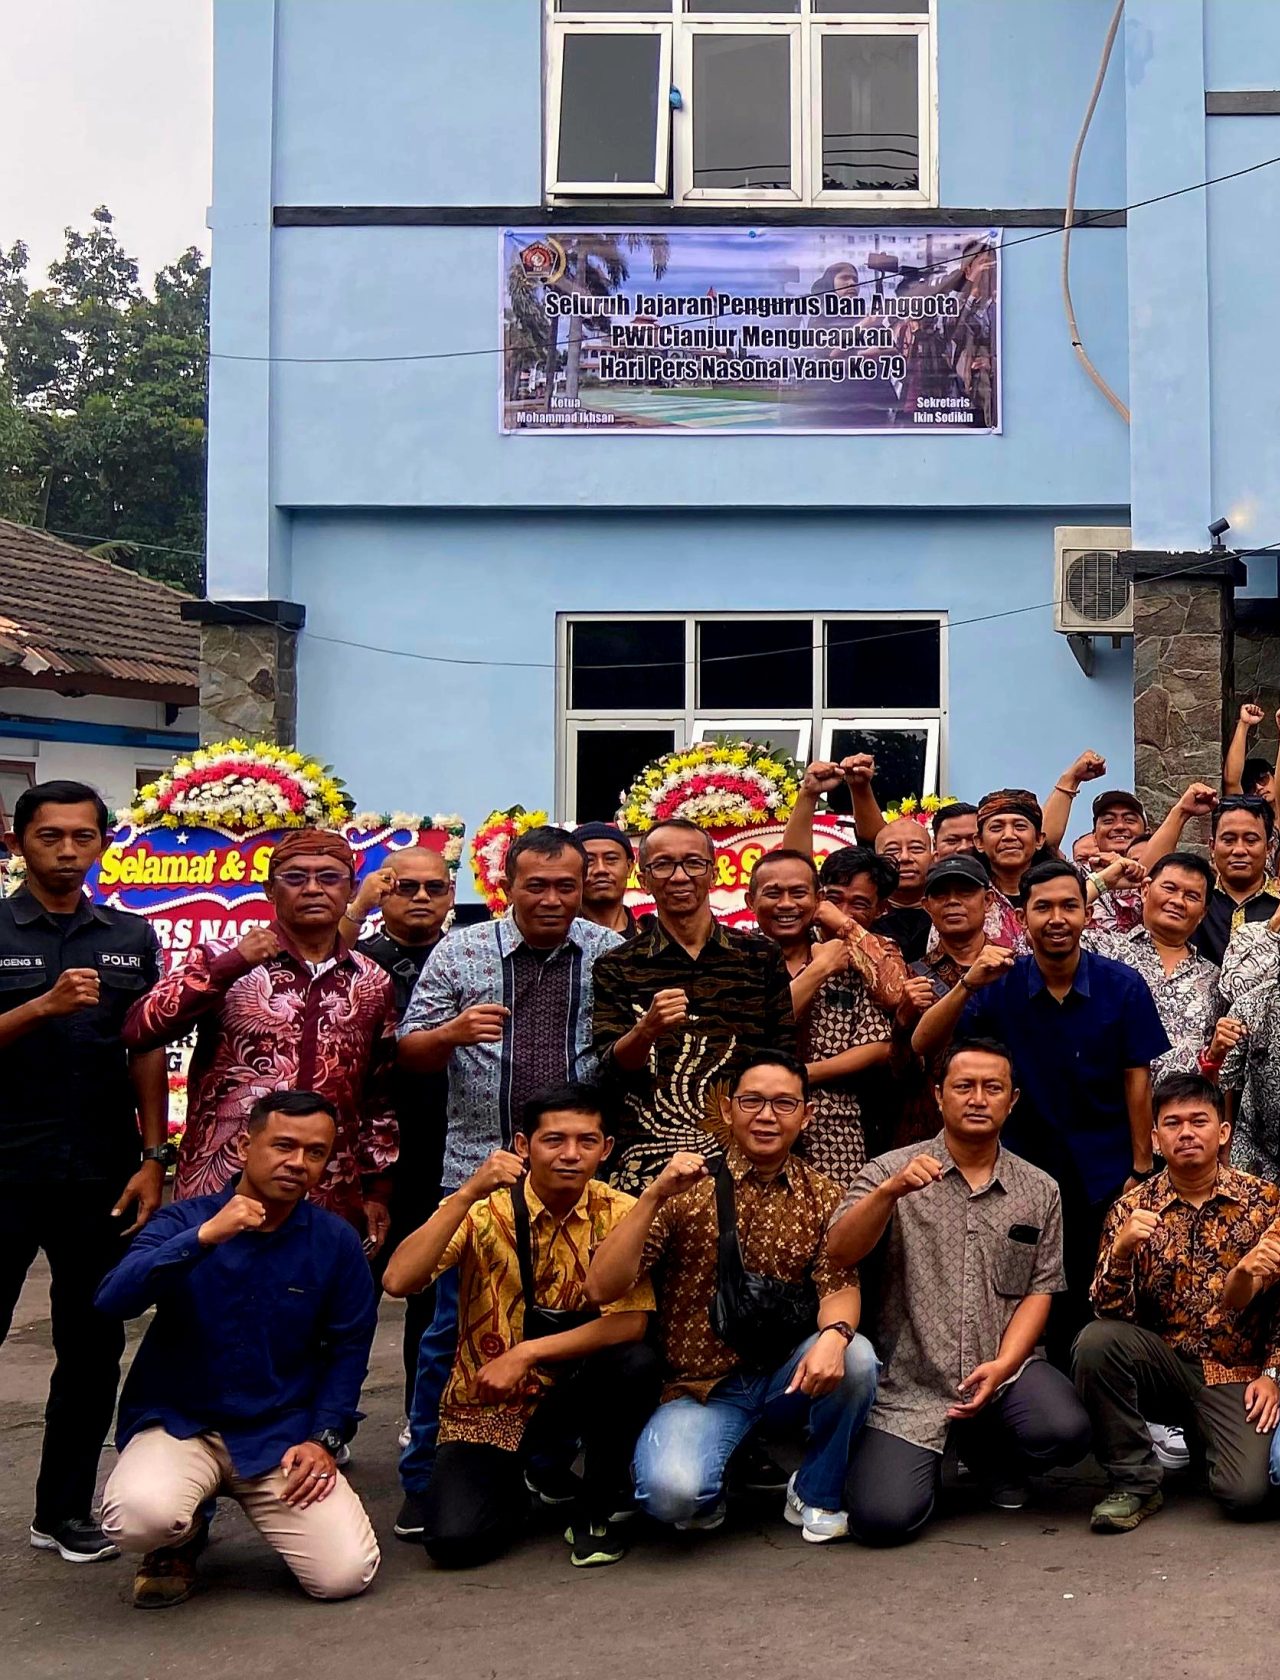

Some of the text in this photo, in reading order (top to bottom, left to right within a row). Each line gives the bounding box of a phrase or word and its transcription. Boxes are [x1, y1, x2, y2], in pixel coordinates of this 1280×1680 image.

[545, 292, 960, 318] Seluruh Jajaran Pengurus Dan Anggota
[611, 324, 893, 350] PWI Cianjur Mengucapkan
[600, 355, 906, 382] Hari Pers Nasonal Yang Ke 79
[550, 397, 581, 408] Ketua
[916, 396, 970, 408] Sekretaris
[516, 411, 615, 424] Mohammad Ikhsan
[913, 411, 974, 423] Ikin Sodikin
[98, 846, 217, 885] Selamat
[219, 850, 247, 882] &
[715, 854, 737, 887] &
[149, 918, 194, 950] RS
[0, 958, 31, 967] GENG
[101, 953, 141, 968] POLRI
